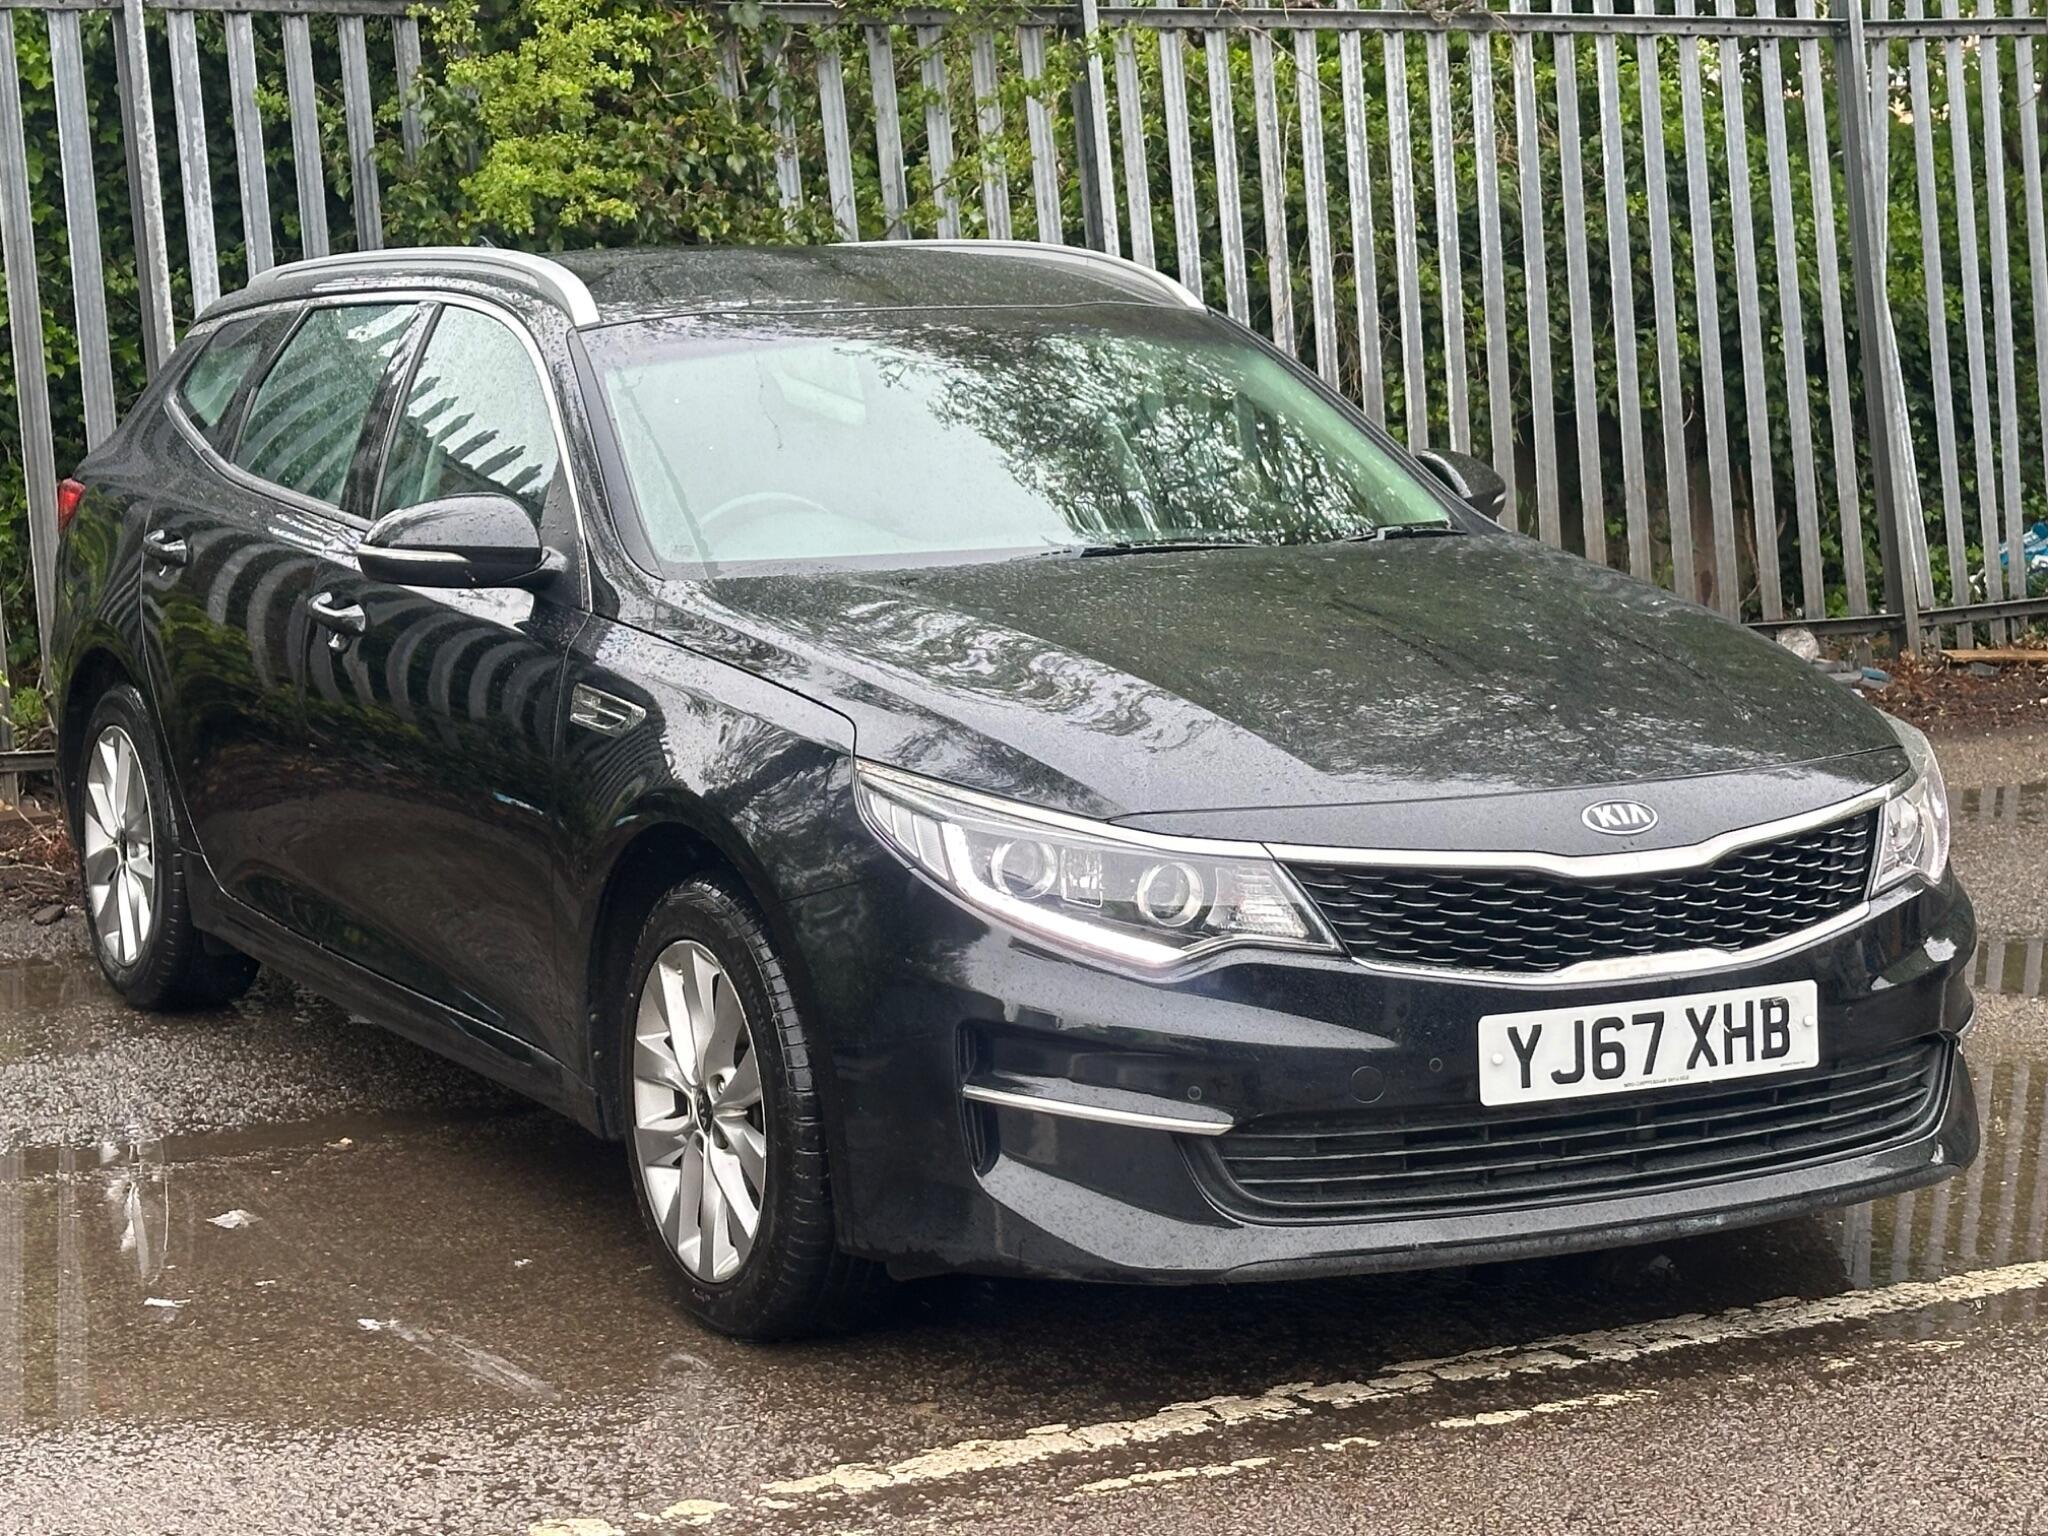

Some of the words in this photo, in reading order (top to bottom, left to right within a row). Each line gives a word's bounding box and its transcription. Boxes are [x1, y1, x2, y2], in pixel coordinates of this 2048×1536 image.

[1591, 803, 1651, 827] KIA
[1506, 1010, 1665, 1089] YJ67
[1685, 997, 1790, 1070] XHB
